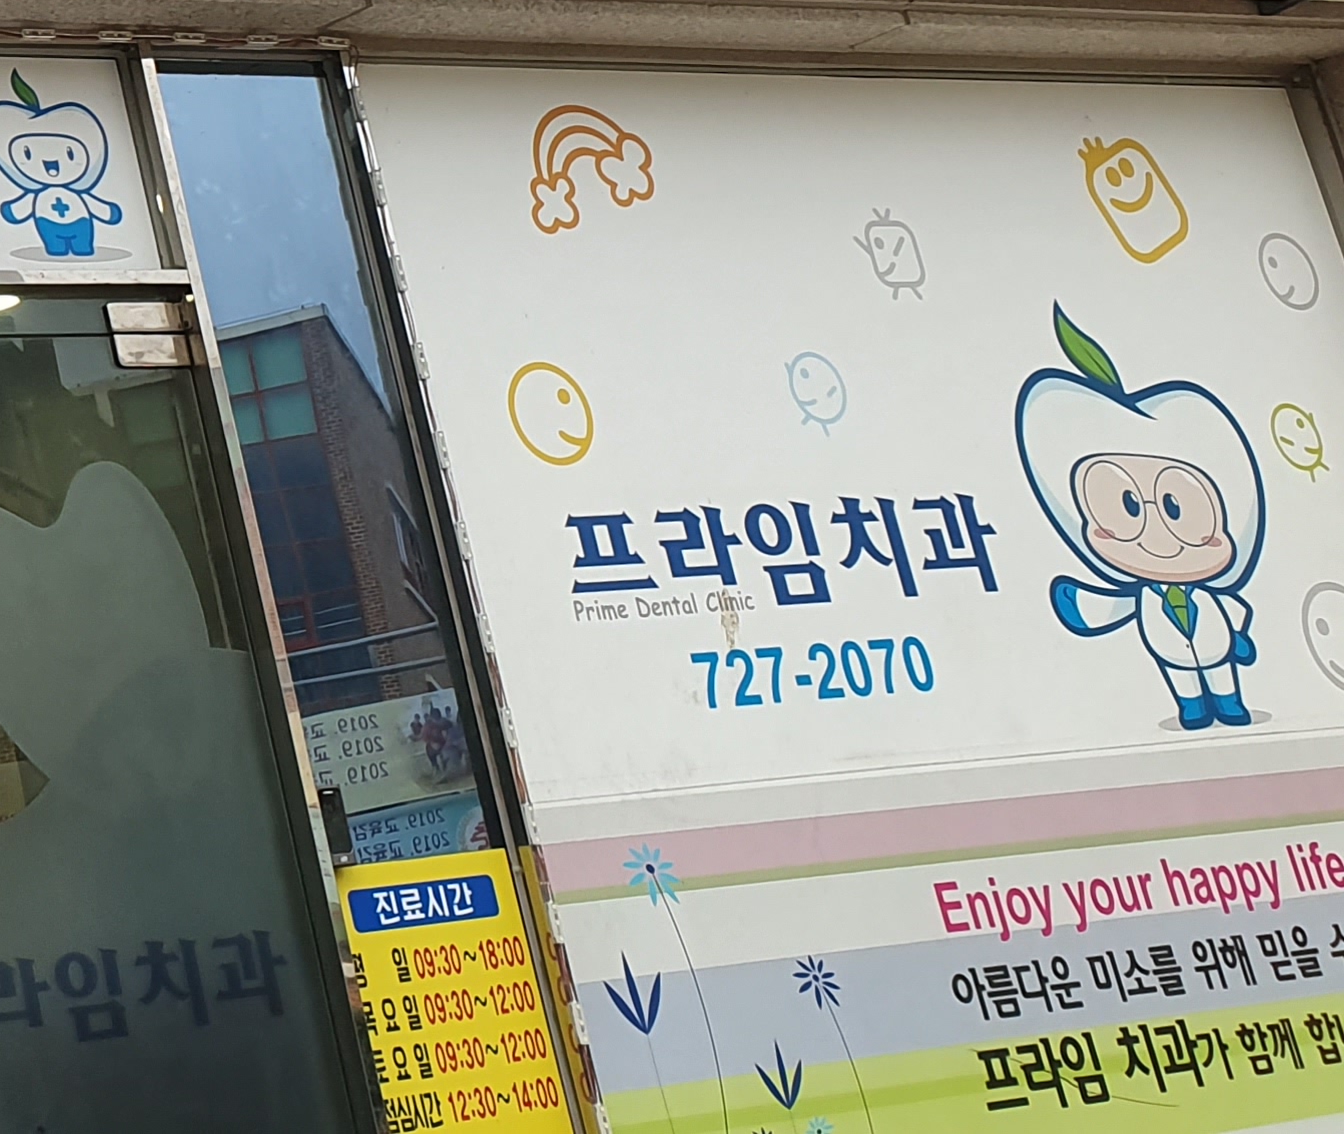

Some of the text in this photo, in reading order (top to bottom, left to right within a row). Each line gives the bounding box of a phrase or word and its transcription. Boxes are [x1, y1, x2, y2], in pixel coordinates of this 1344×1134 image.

[564, 492, 999, 607] 프라임치과
[573, 589, 755, 622] Prime Dental Clinic
[691, 635, 936, 710] 727-2070
[372, 884, 474, 927] 진료시간
[933, 878, 1054, 941] Enjoy
[1062, 870, 1153, 932] your
[1160, 858, 1281, 915] happy
[951, 952, 1086, 1022] 아름다운
[1086, 944, 1187, 1003] 미소를
[1191, 934, 1258, 990] 위해
[1255, 925, 1324, 983] 믿을
[976, 1012, 1344, 1112] 프라임 치과가 함께 합
